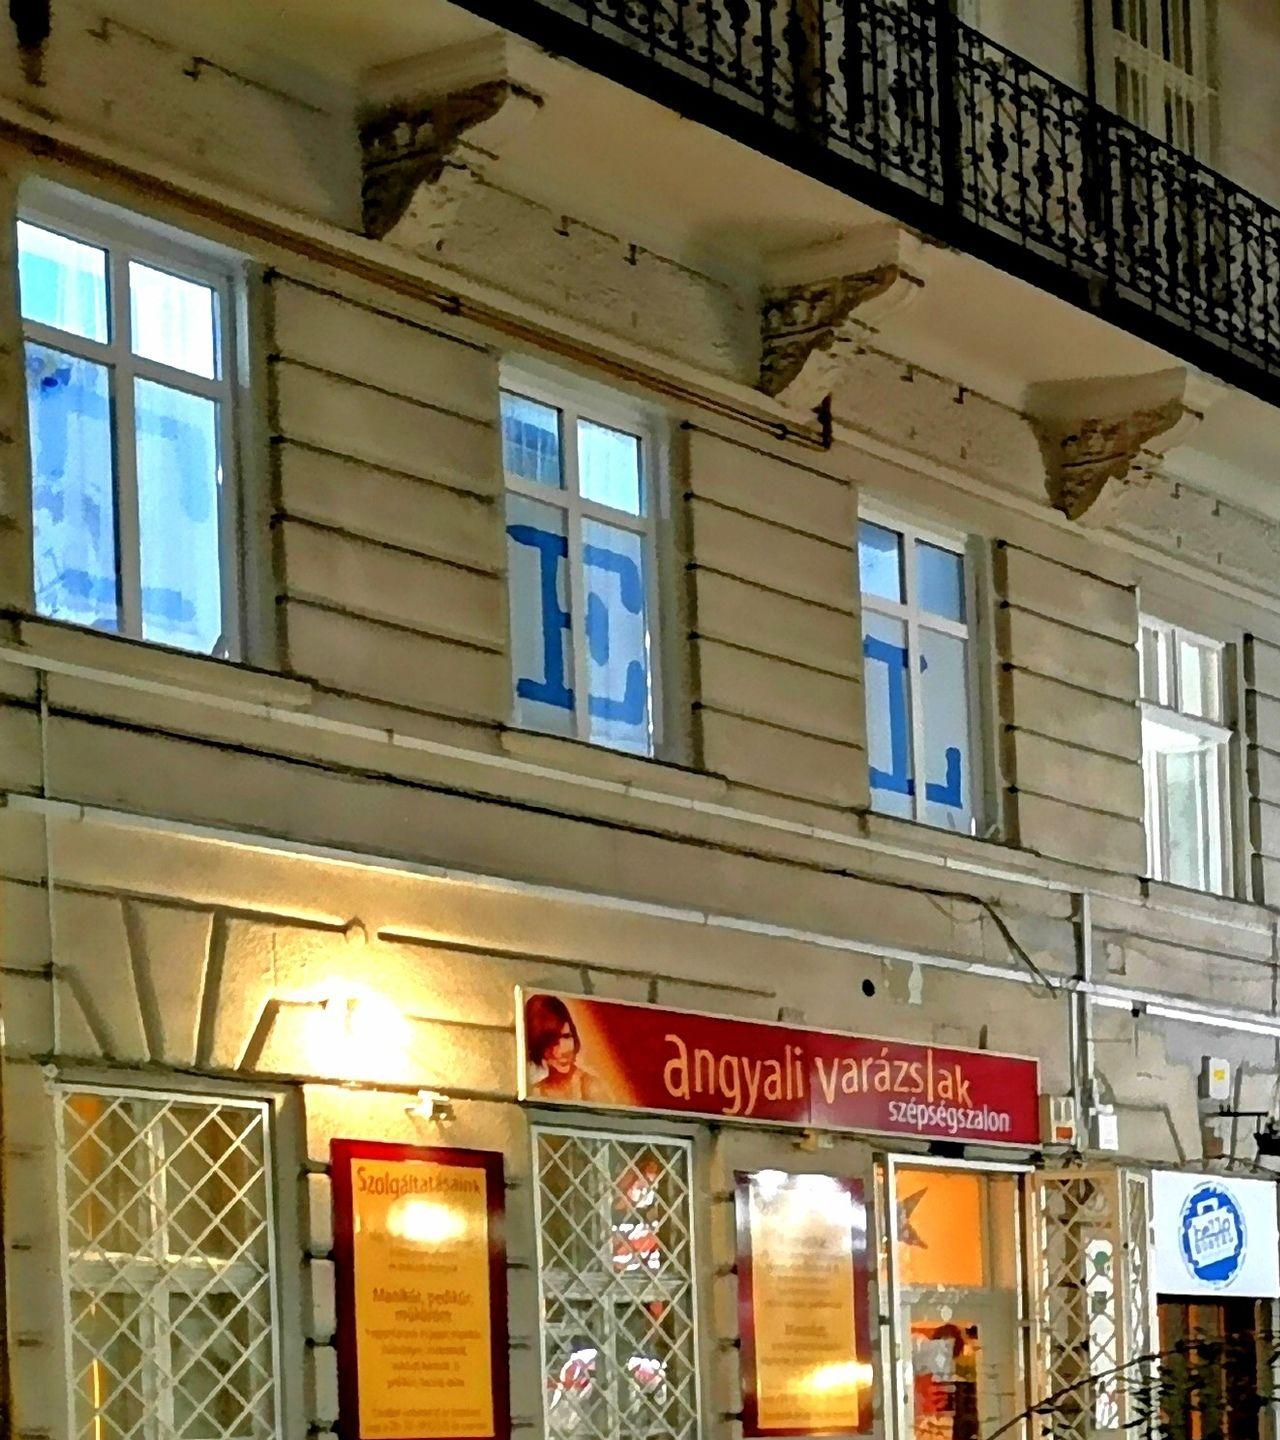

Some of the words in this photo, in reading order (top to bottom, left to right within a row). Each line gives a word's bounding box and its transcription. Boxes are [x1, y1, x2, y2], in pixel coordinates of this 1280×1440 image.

[664, 1033, 804, 1116] angyali
[815, 1047, 972, 1108] varázslak
[888, 1100, 1011, 1134] szépségszalon
